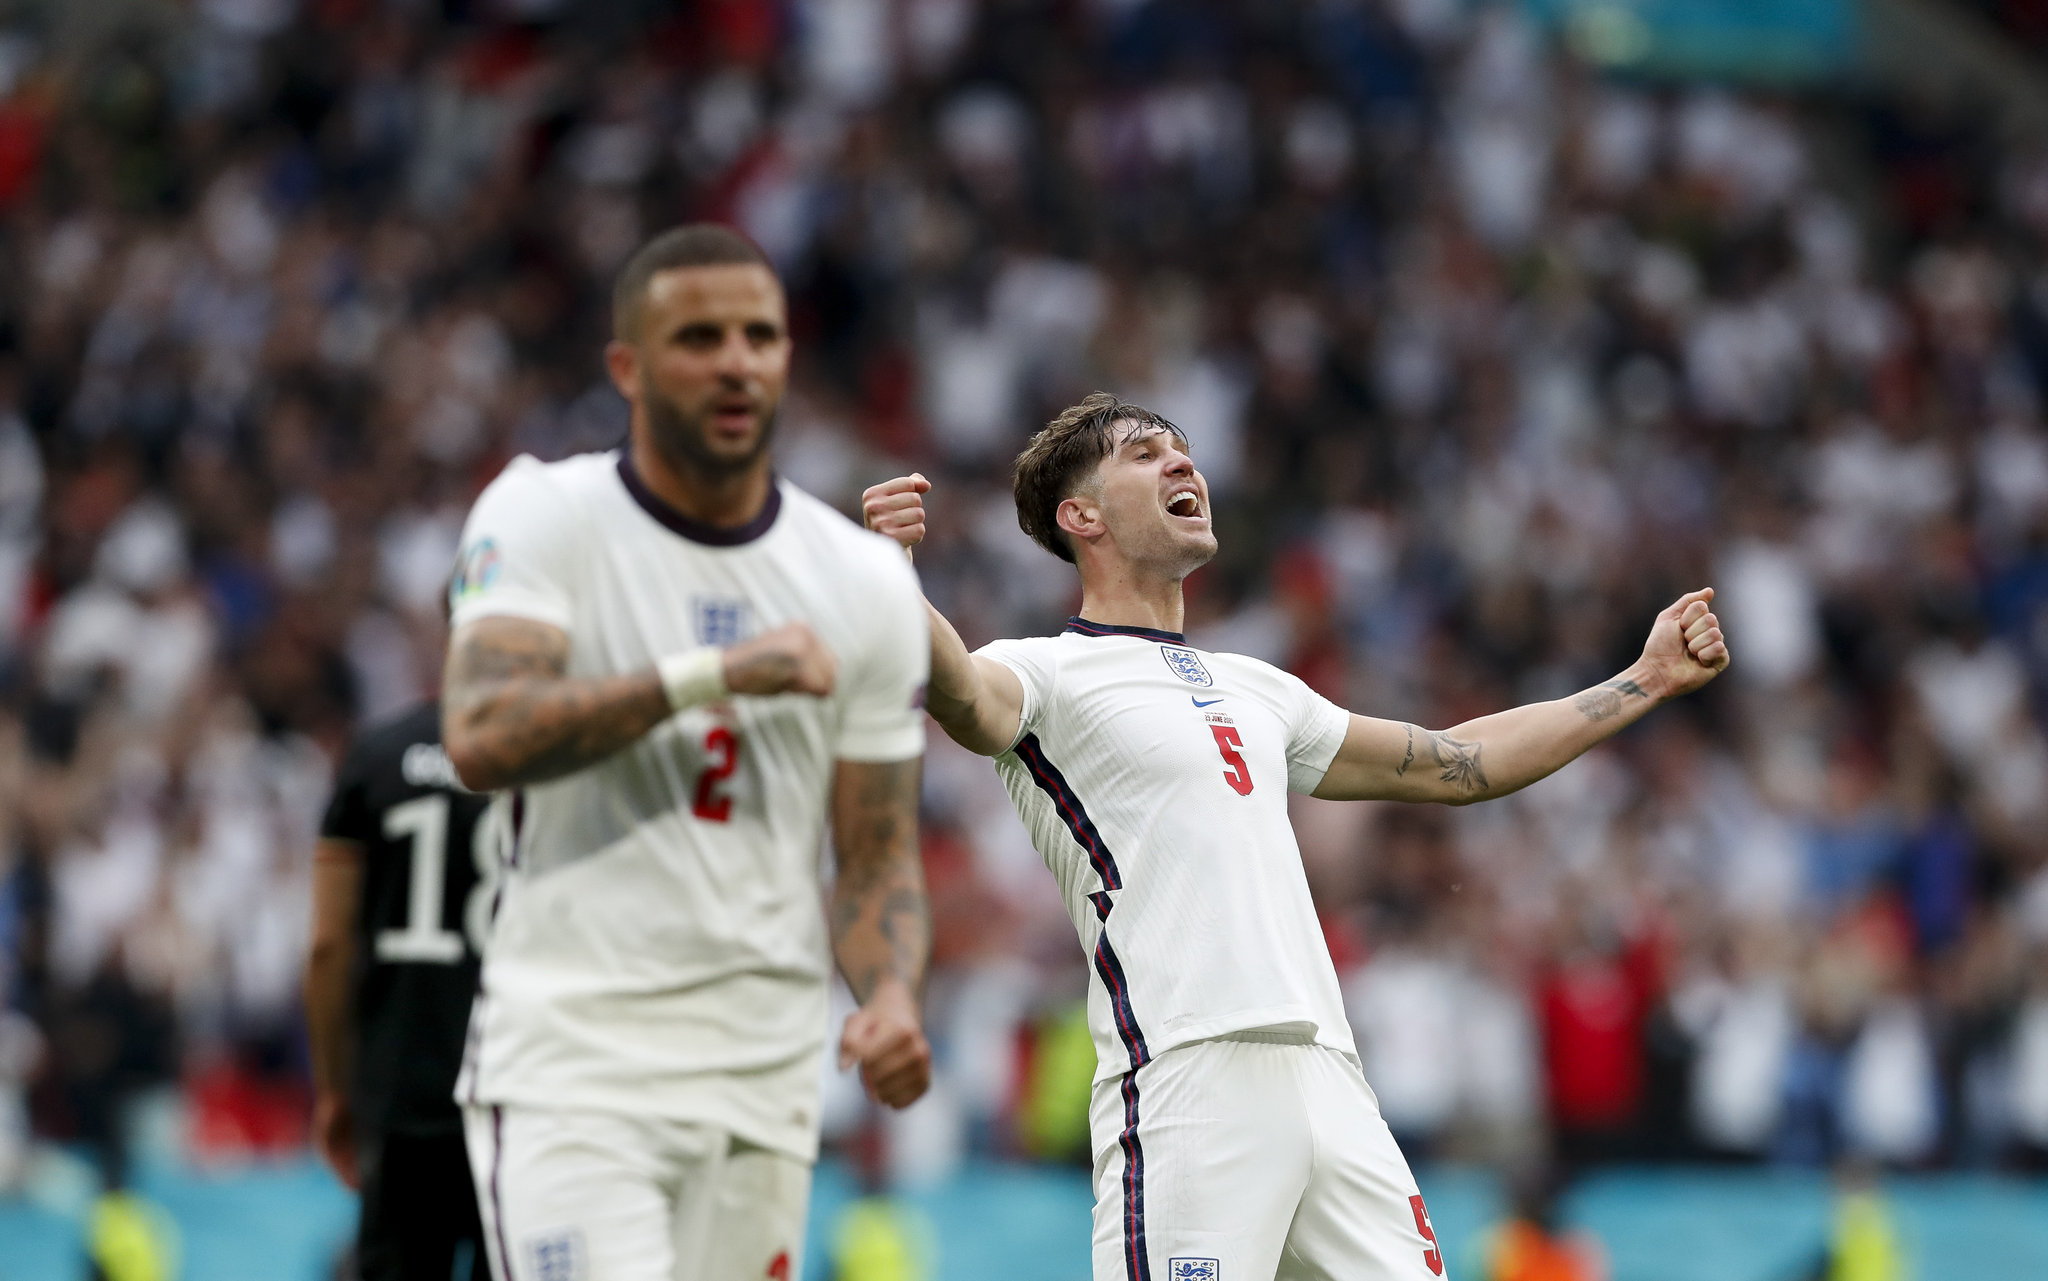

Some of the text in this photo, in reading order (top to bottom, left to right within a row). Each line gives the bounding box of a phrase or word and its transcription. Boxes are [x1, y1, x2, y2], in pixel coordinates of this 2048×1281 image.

[1212, 715, 1223, 723] JUNE
[692, 727, 737, 823] 2
[1208, 724, 1254, 796] 5
[1408, 1194, 1443, 1276] 5
